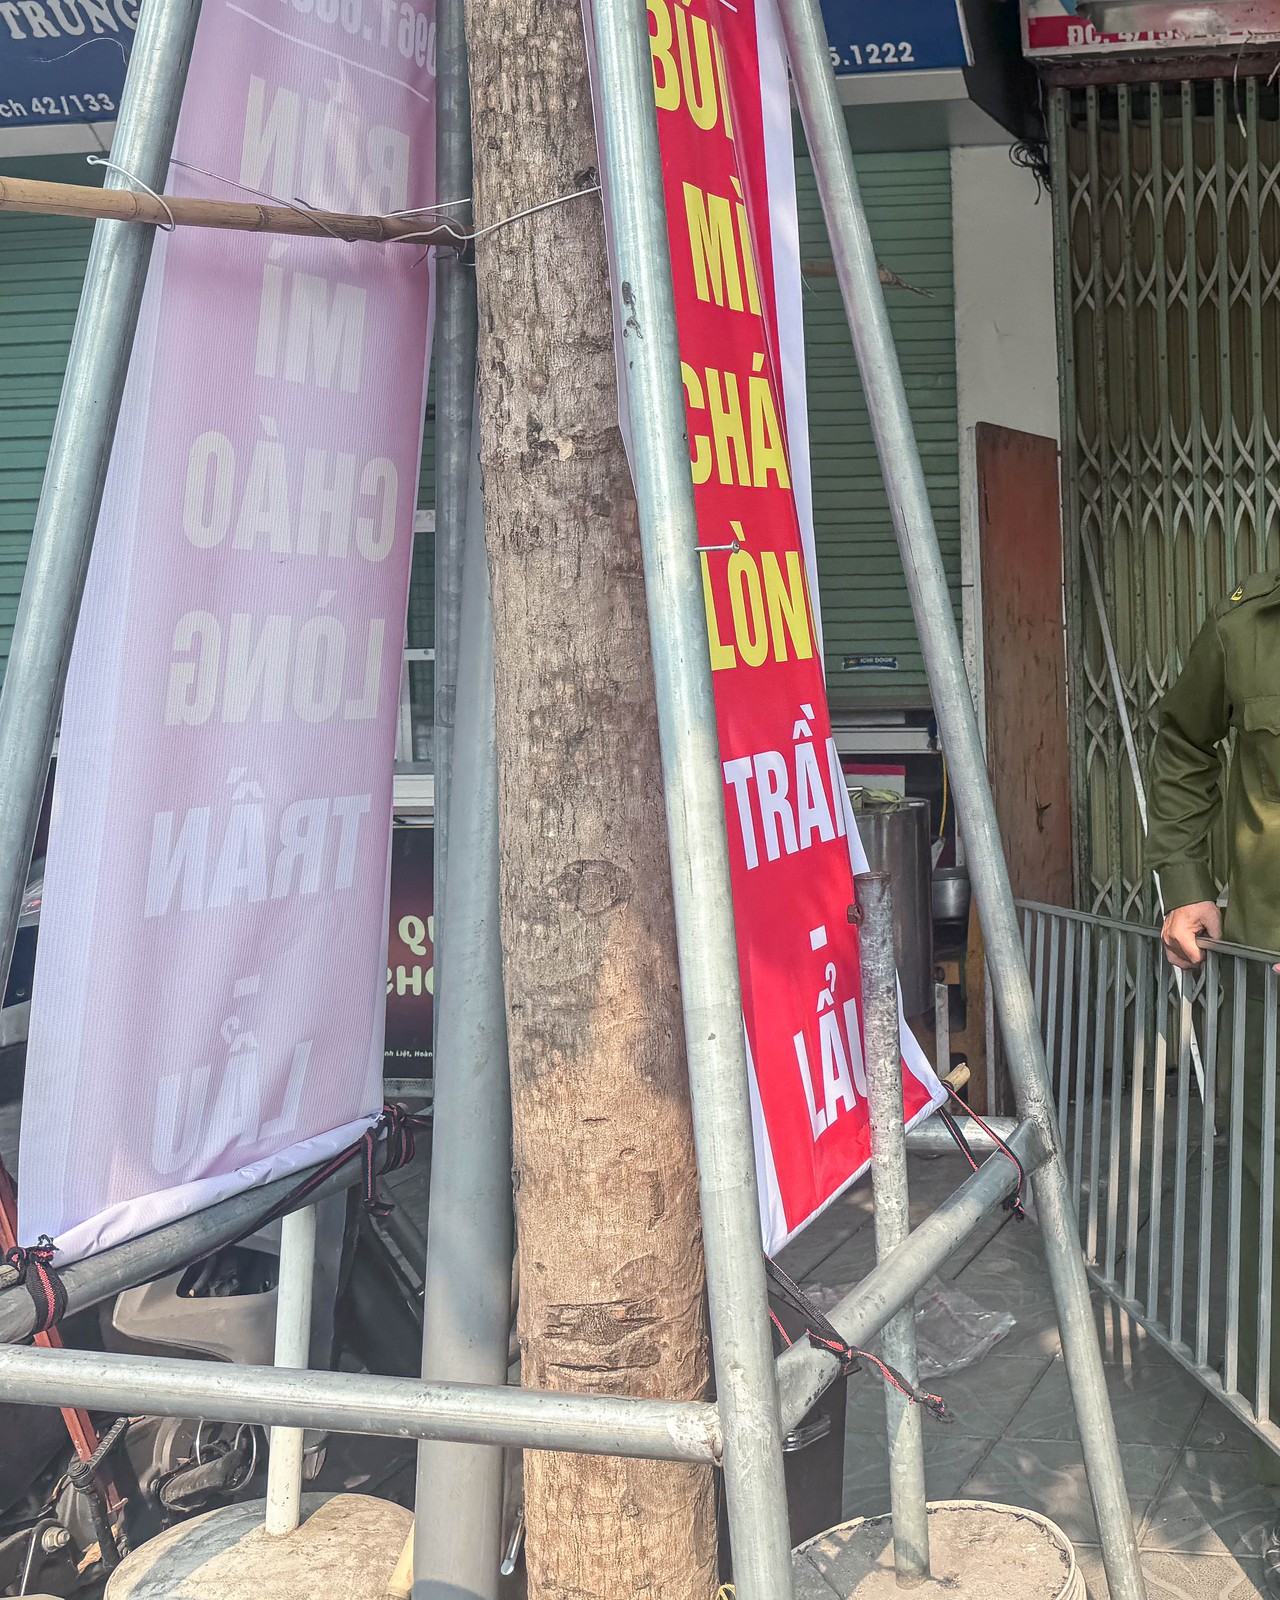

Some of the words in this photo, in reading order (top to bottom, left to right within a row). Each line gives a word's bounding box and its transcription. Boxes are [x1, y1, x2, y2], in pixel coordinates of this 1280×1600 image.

[31, 93, 115, 116] 42/133
[645, 0, 734, 140] BÚ
[682, 175, 762, 316] MÌ
[700, 521, 819, 671] LÒN
